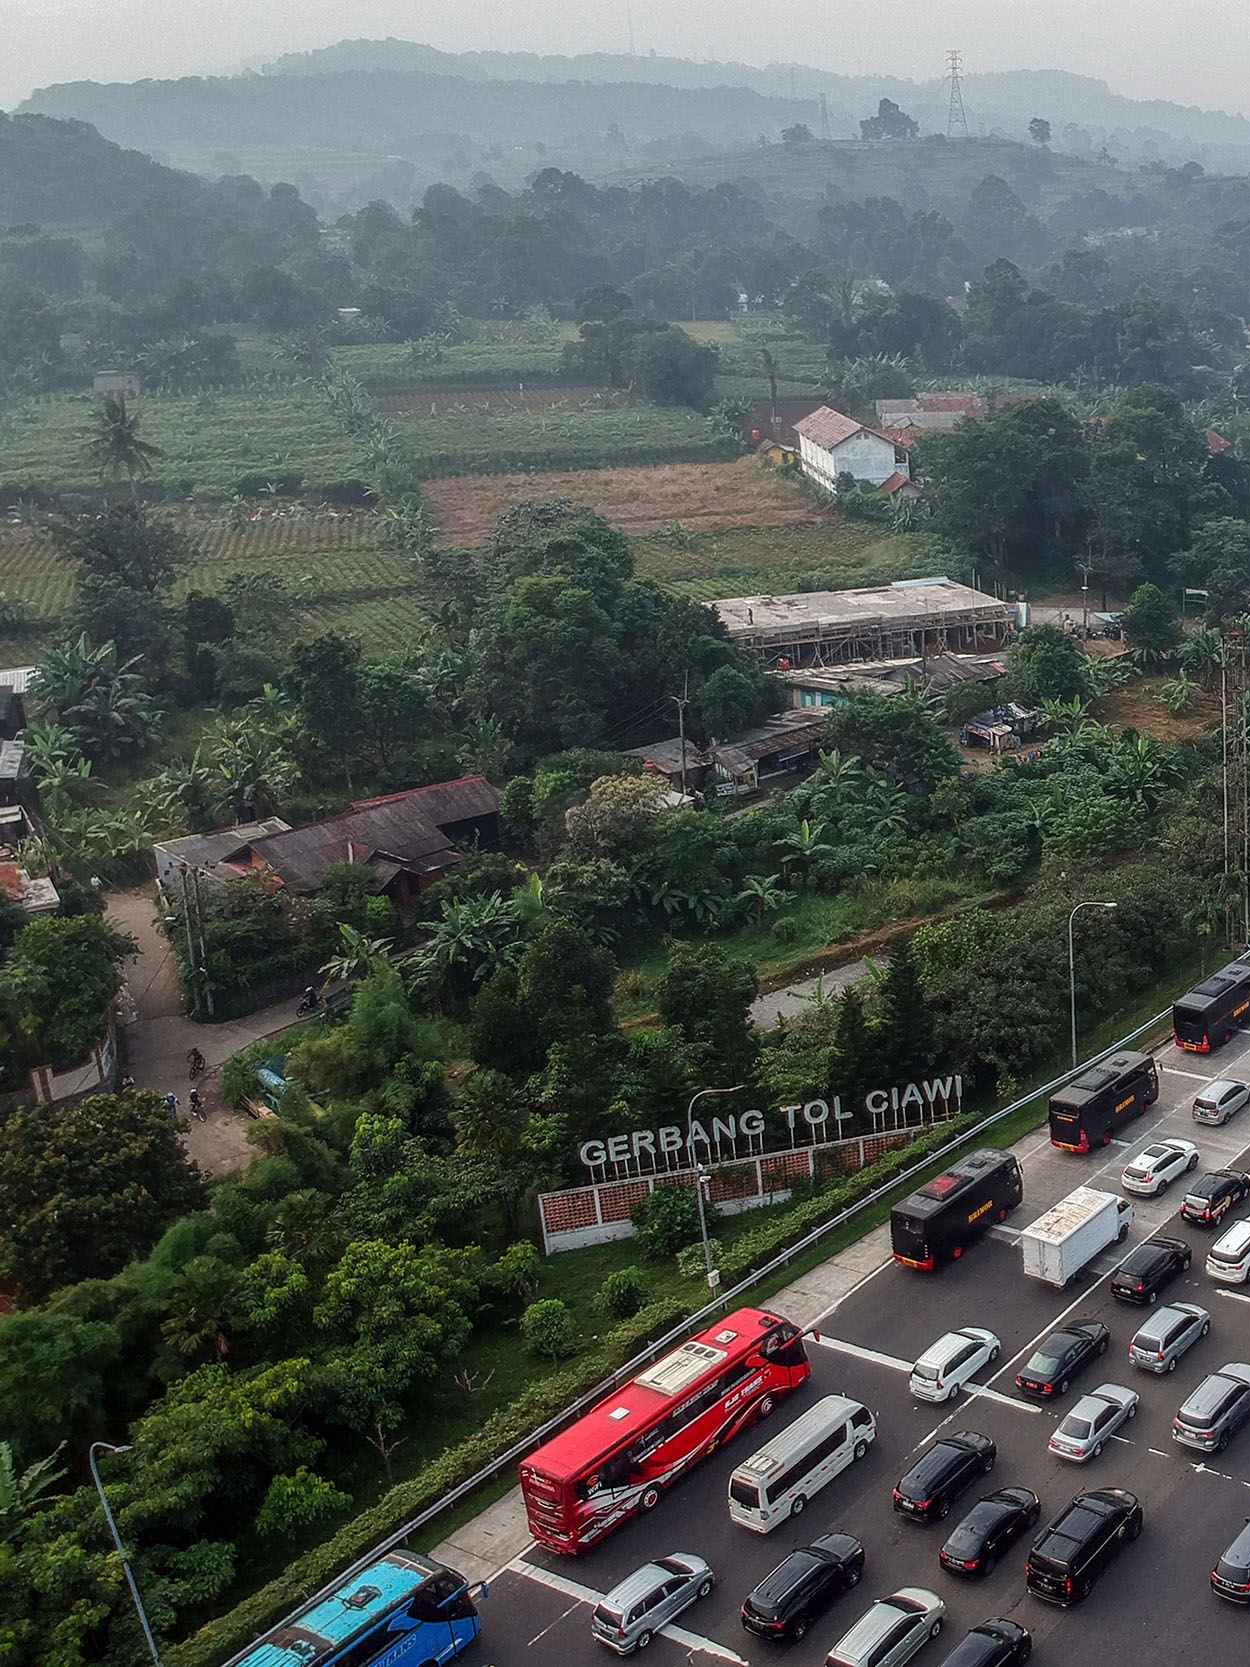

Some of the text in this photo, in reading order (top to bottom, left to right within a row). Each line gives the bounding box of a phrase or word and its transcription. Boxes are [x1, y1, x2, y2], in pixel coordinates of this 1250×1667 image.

[580, 1074, 963, 1167] GERBANG TOL CIAWI
